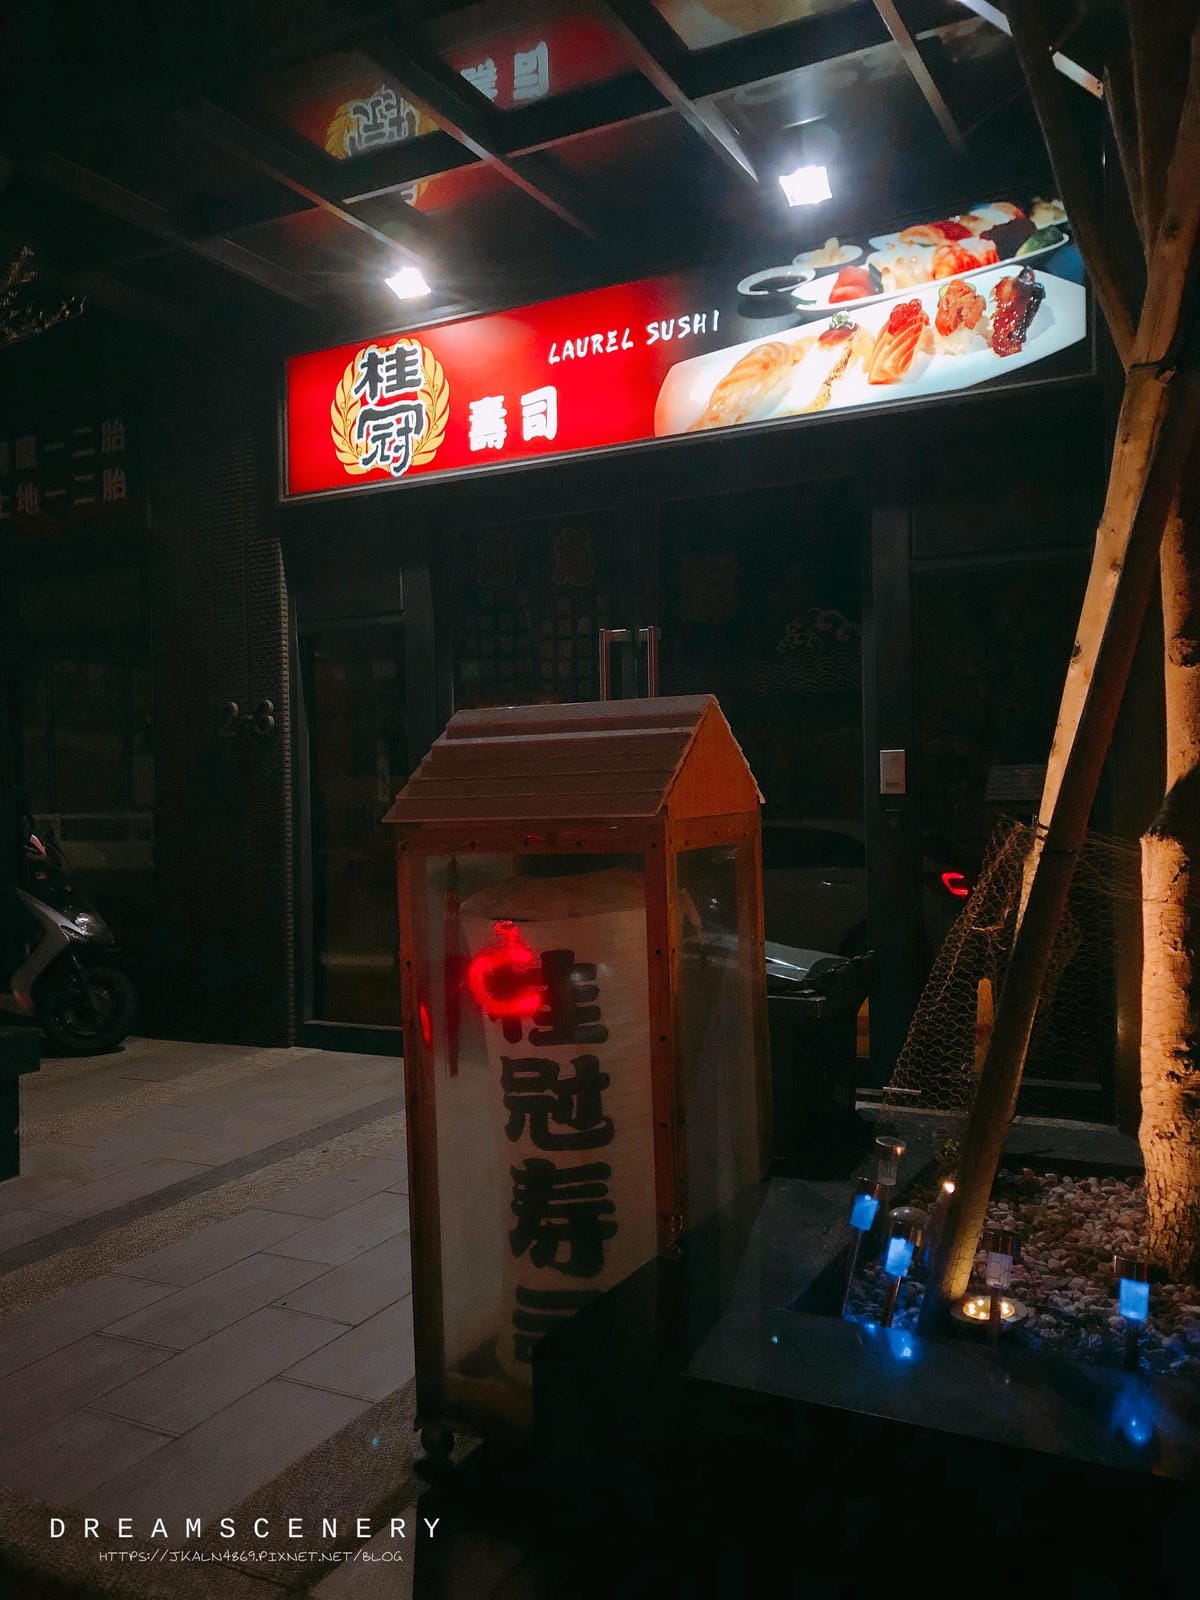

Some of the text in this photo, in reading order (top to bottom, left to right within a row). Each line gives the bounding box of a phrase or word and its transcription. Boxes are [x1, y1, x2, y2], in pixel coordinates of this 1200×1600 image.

[548, 309, 720, 365] LAUREL SUSHI
[353, 344, 426, 477] 桂冠
[468, 385, 559, 452] 壽司
